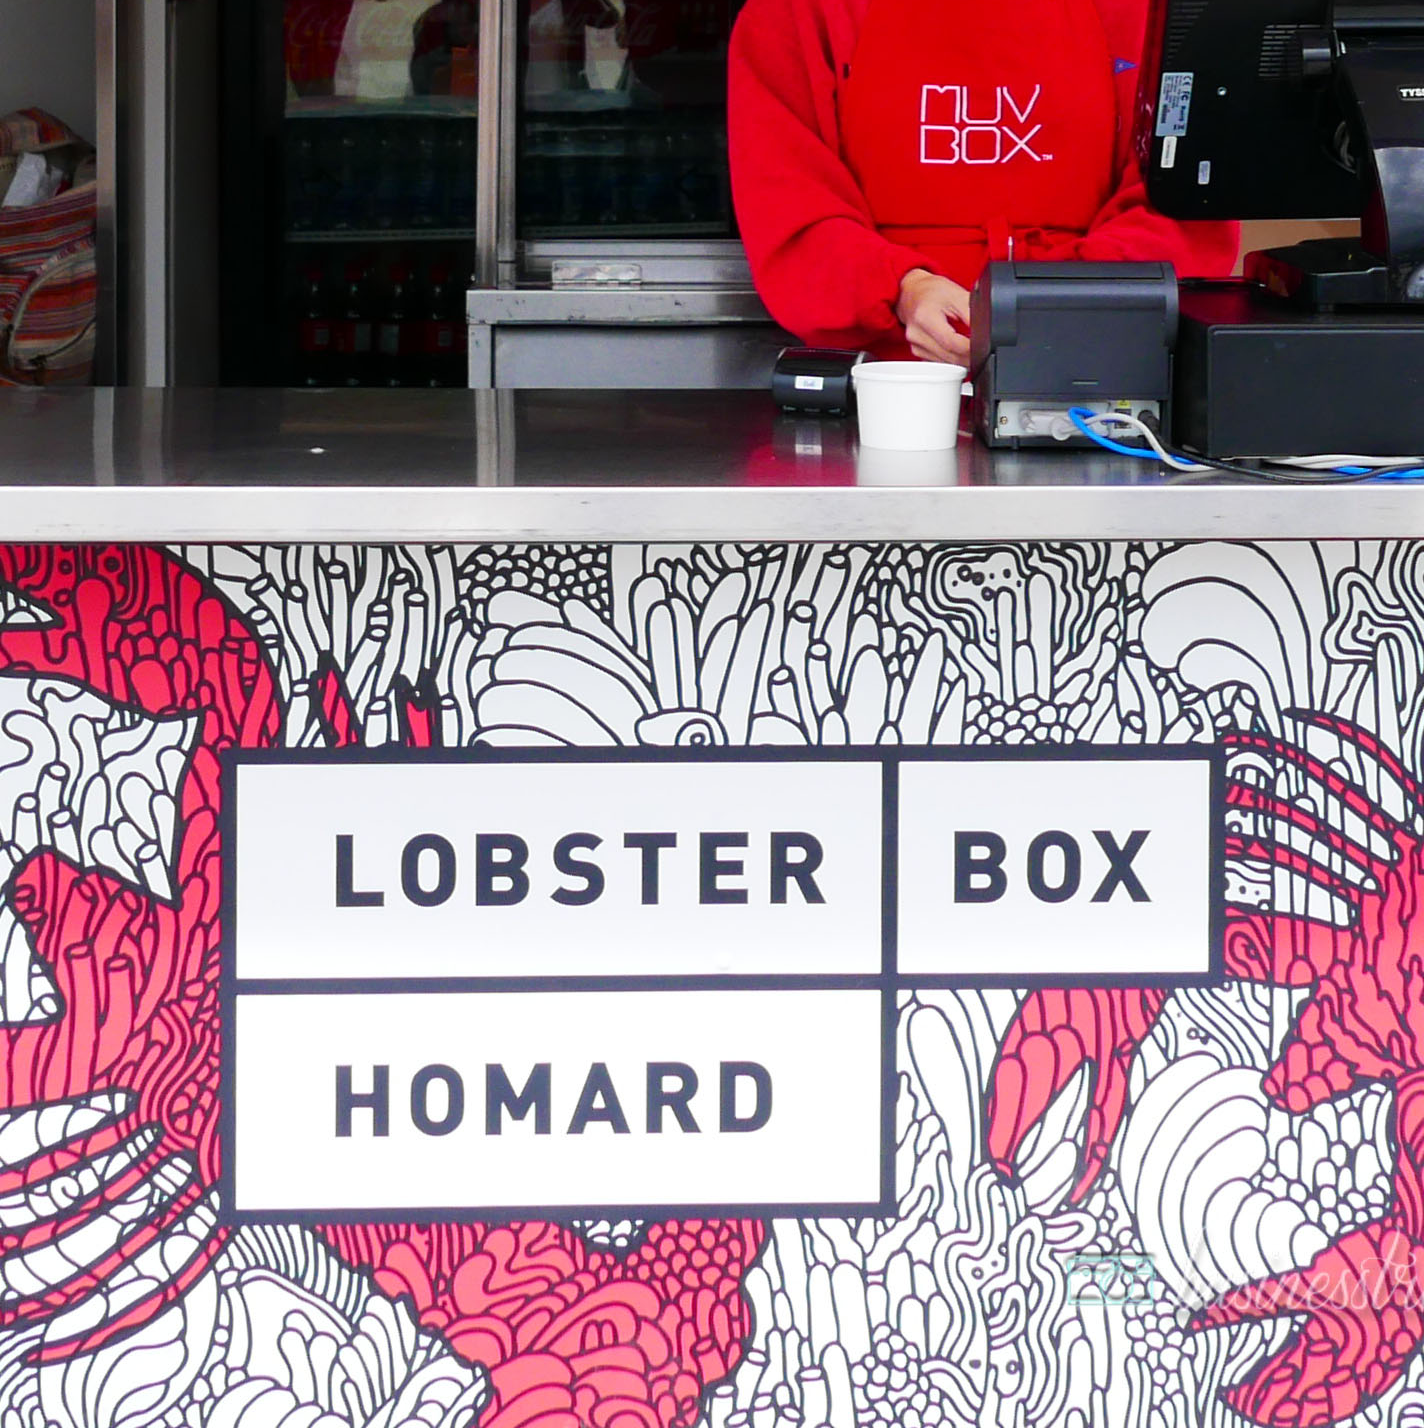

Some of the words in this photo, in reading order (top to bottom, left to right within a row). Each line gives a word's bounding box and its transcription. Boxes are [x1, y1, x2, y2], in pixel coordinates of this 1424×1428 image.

[920, 83, 1041, 124] MUV
[920, 124, 1043, 164] BOX
[335, 831, 827, 908] LOBSTER
[953, 829, 1152, 904] BOX
[335, 1060, 773, 1138] HOMARD
